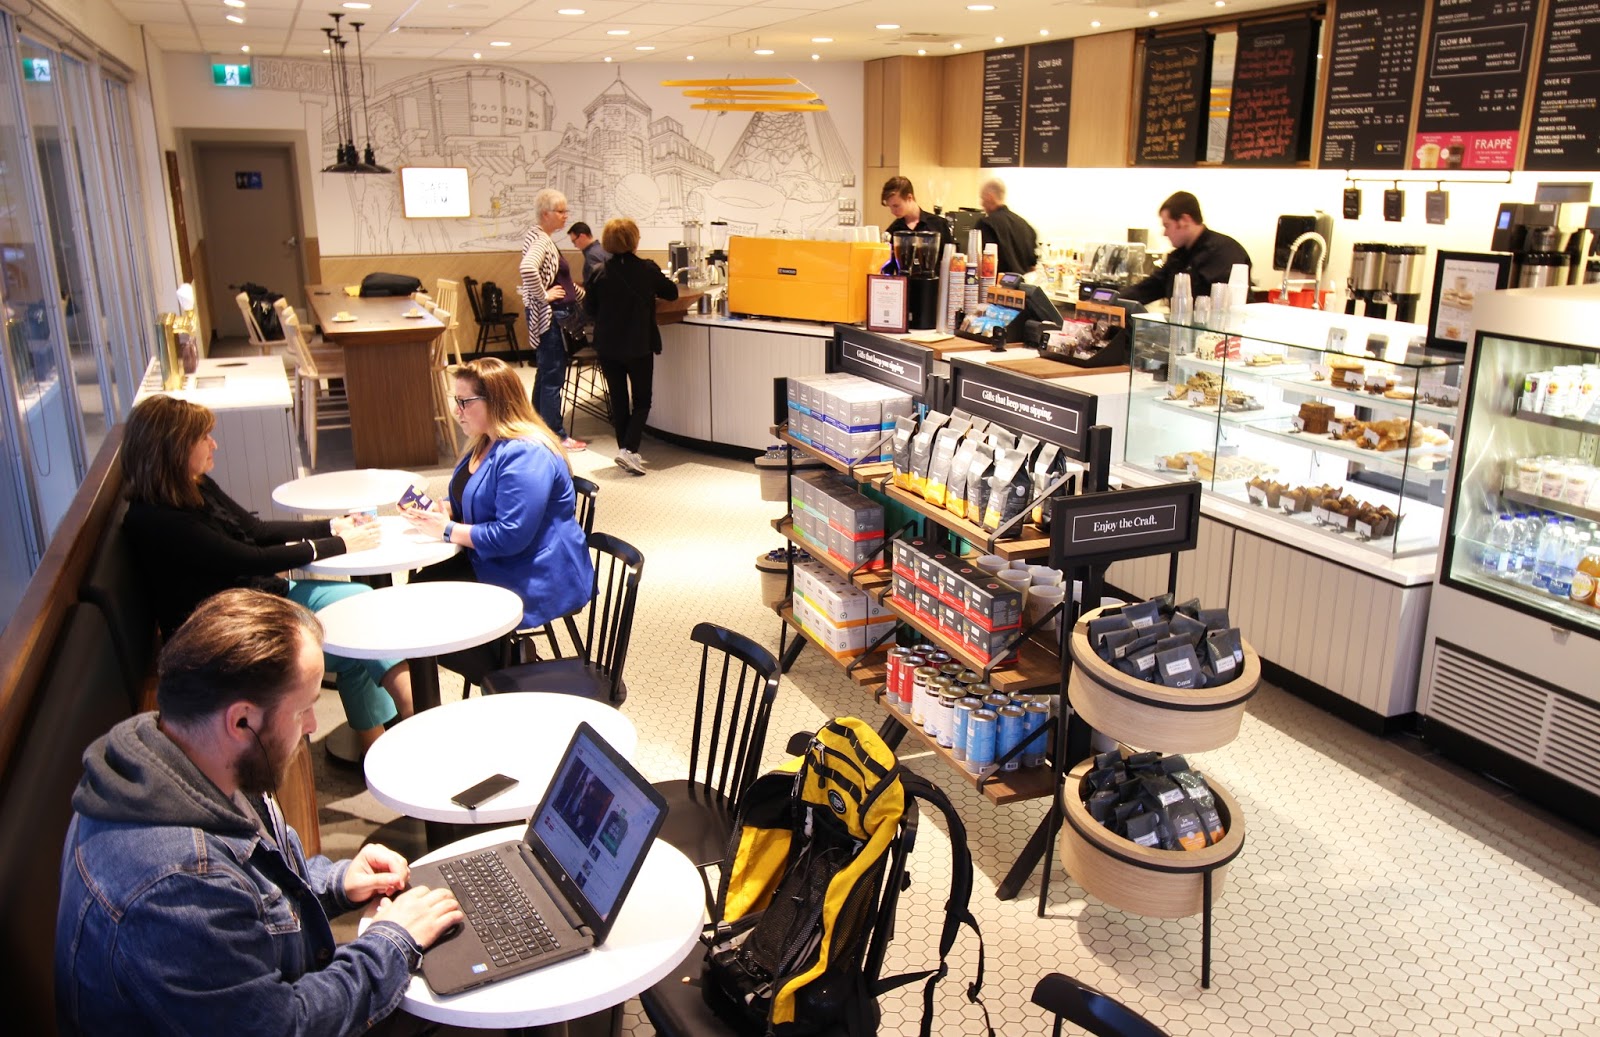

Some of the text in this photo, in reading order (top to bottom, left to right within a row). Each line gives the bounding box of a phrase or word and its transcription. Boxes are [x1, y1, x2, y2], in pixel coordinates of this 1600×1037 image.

[1340, 8, 1378, 19] ESPRESSO BAR
[1440, 36, 1472, 46] SLOW BAR
[1038, 58, 1062, 68] SLOW BAR
[1544, 78, 1560, 86] OVER
[1475, 136, 1512, 150] FRAPPÉ
[856, 350, 866, 360] Gifts
[872, 354, 882, 367] keep
[881, 360, 889, 368] you
[982, 390, 1053, 421] Gifts that keep you sipping.
[1093, 514, 1158, 533] Enjoy the Craft.
